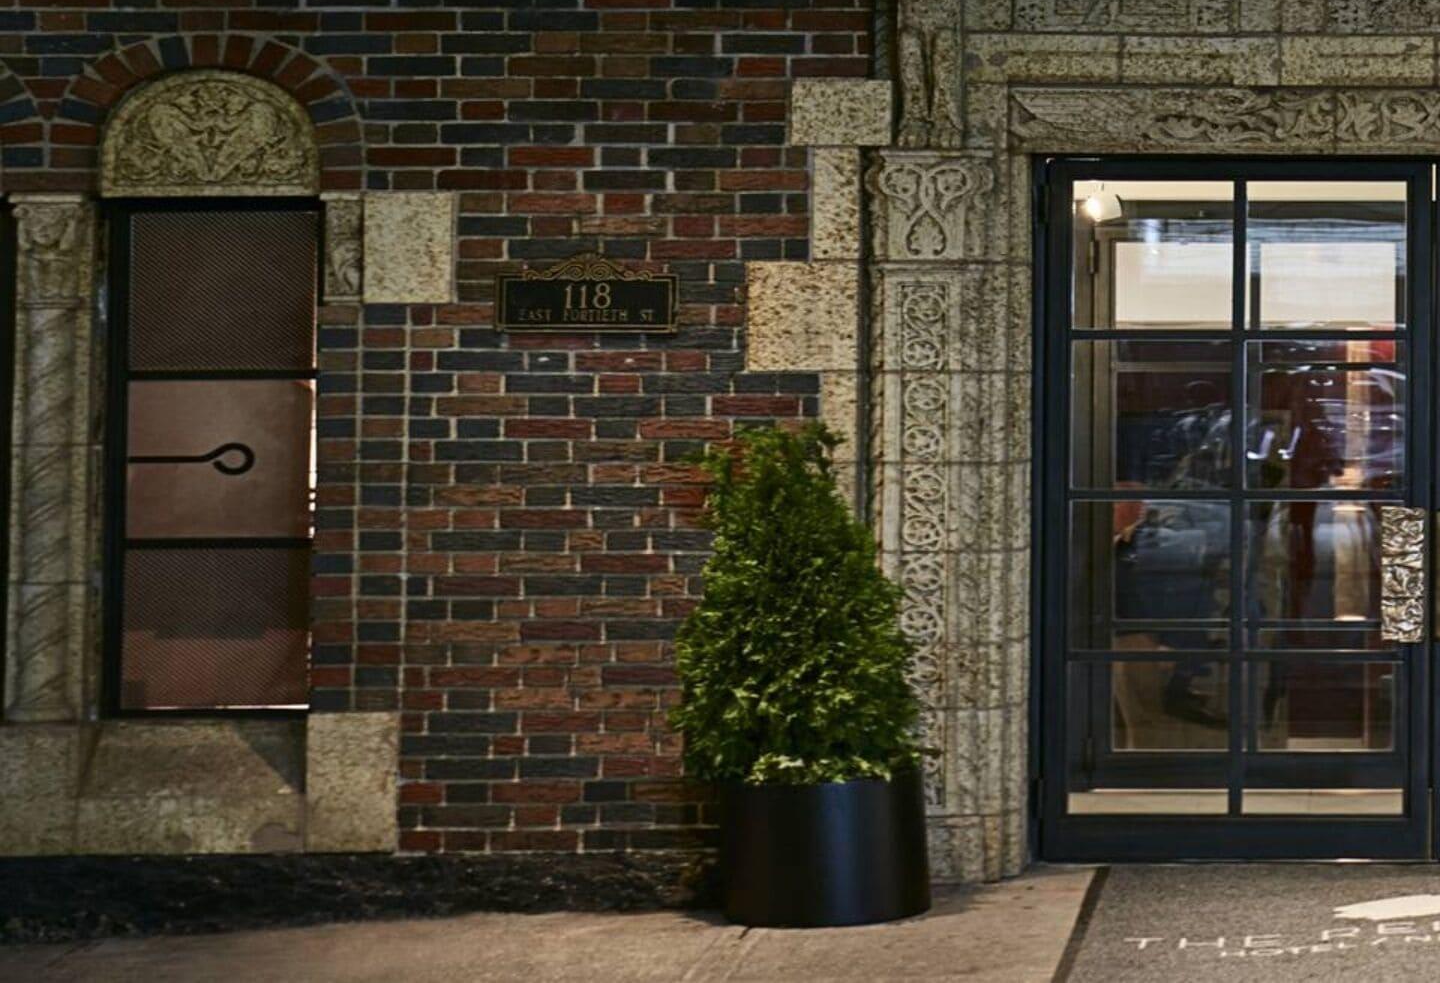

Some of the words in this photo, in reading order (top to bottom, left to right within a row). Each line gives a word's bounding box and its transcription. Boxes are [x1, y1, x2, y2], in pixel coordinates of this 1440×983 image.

[564, 282, 612, 309] 118
[519, 309, 553, 321] EAST
[563, 309, 628, 321] FORTIETH
[1123, 933, 1284, 950] THE
